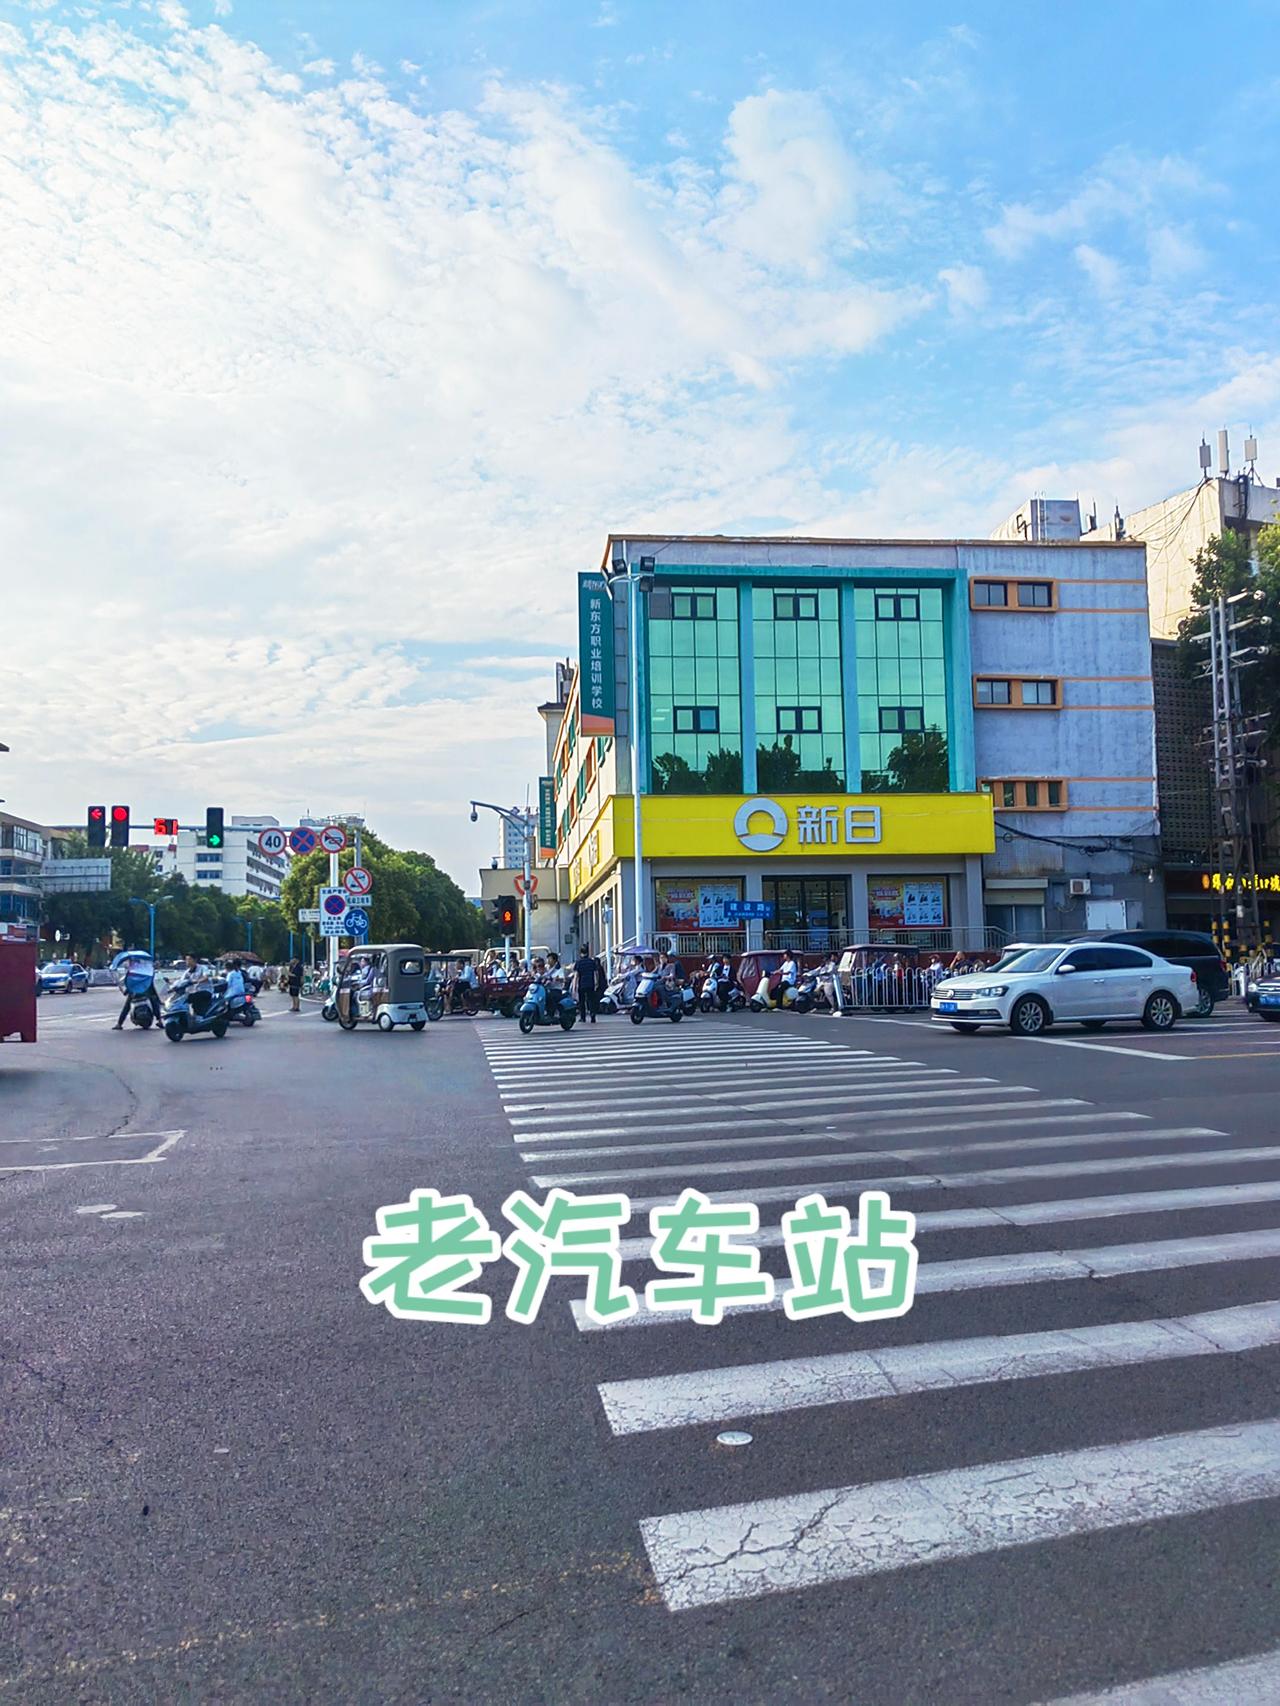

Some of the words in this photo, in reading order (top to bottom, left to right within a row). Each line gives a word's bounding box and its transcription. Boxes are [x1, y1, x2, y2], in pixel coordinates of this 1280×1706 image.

[590, 598, 603, 709] 新东方职业培训学校
[265, 836, 282, 849] 40
[797, 805, 882, 844] 新日
